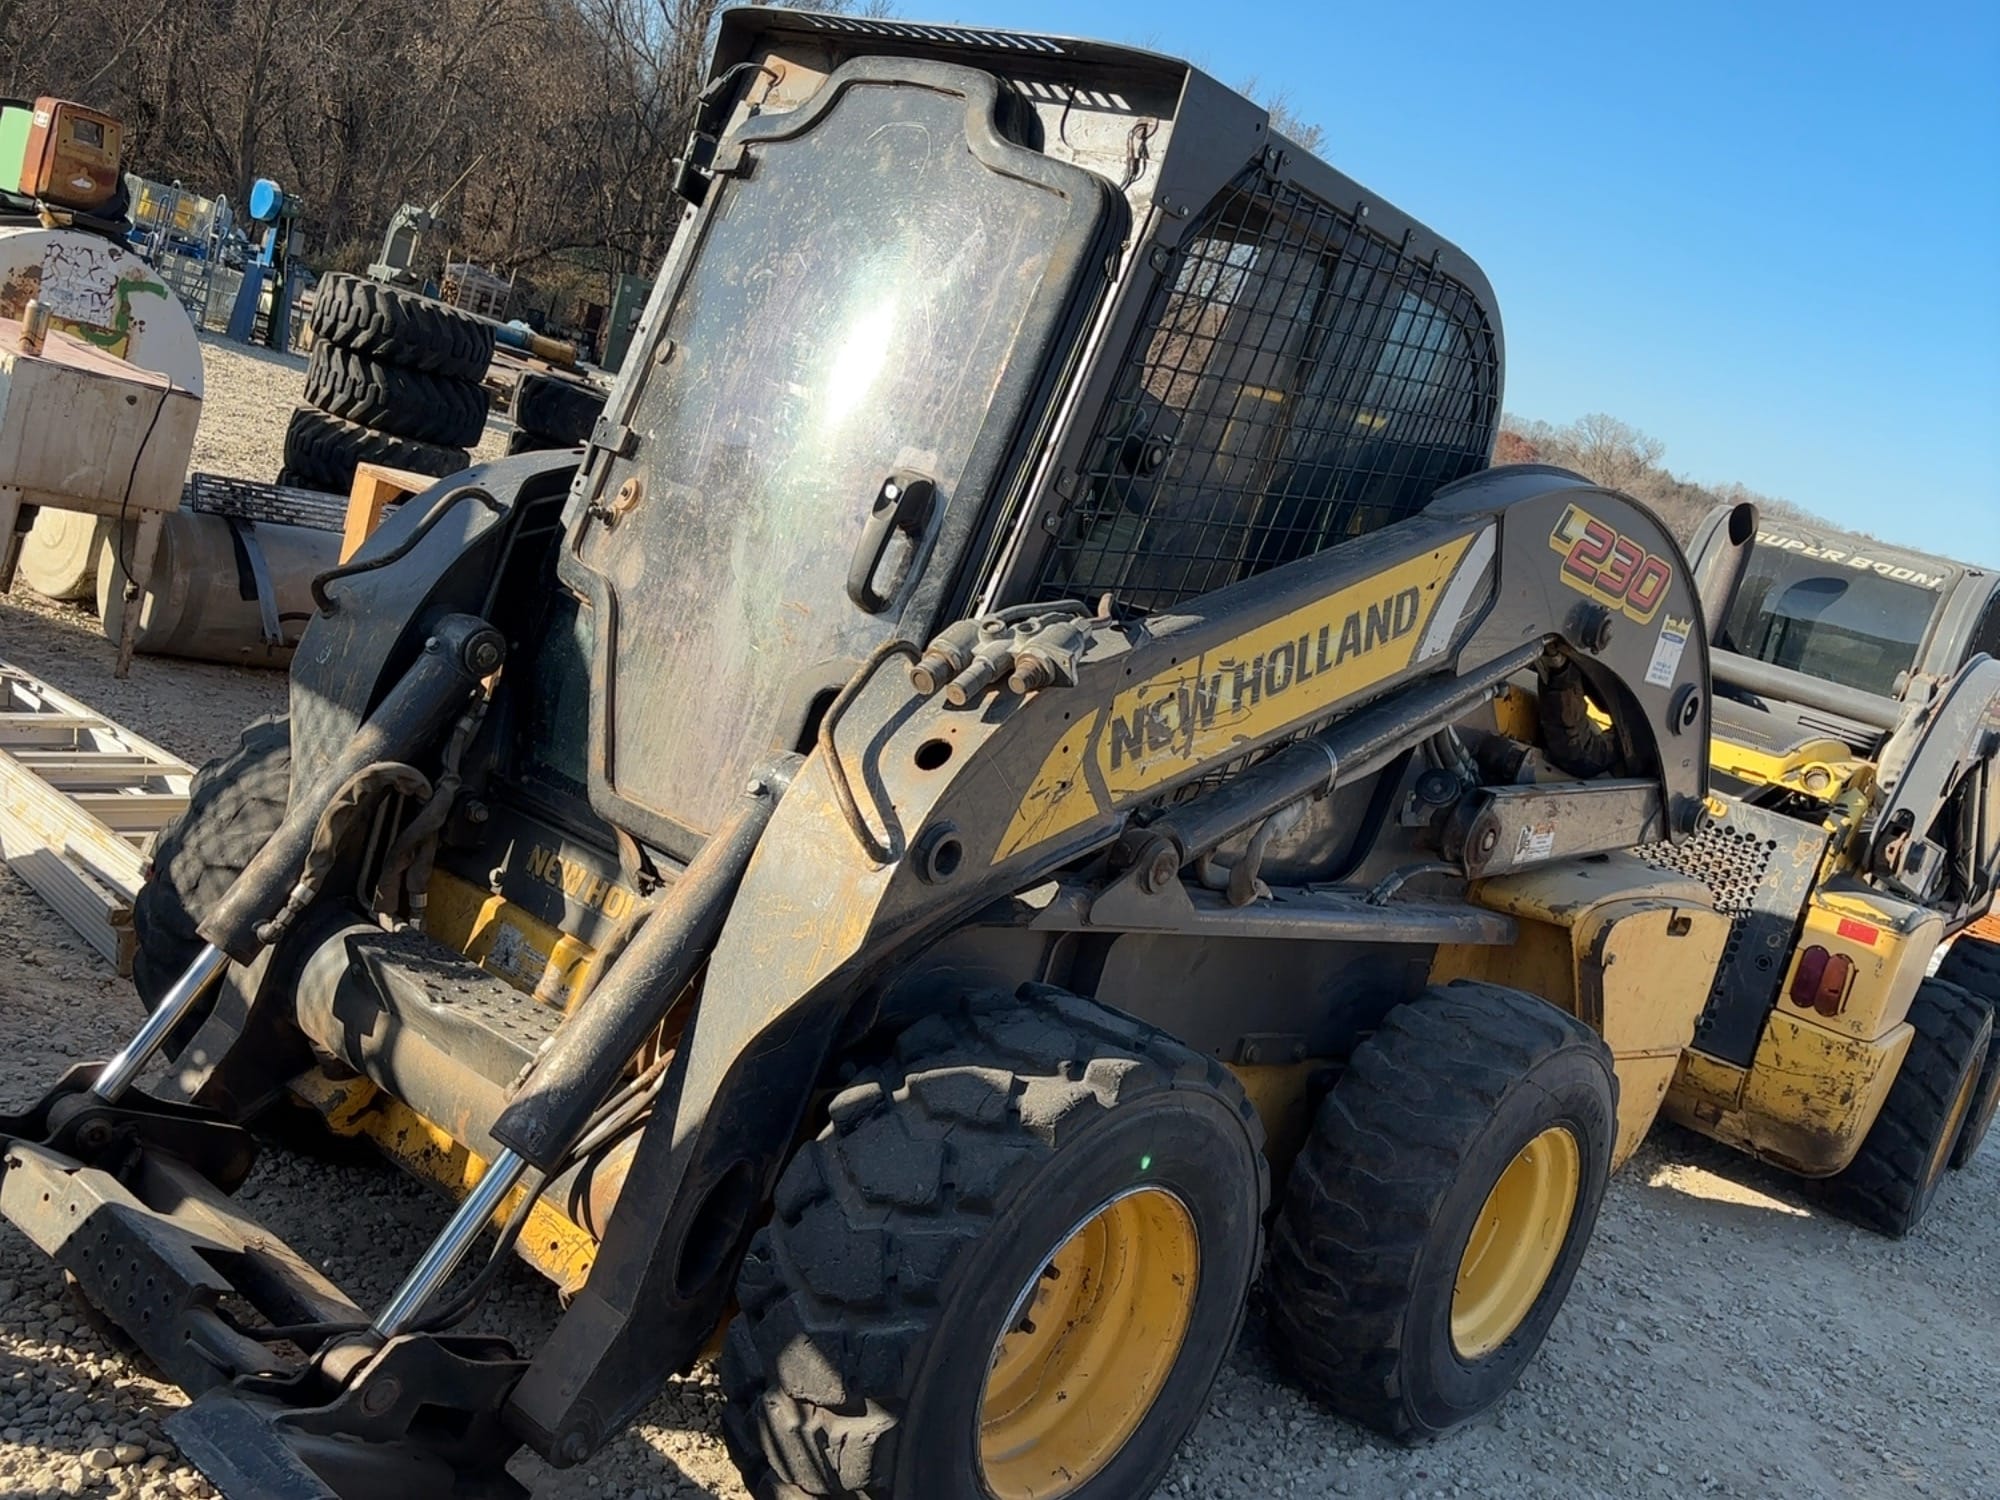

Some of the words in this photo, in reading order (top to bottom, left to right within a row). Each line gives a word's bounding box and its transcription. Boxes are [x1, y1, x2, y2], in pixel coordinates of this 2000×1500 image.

[1552, 505, 1672, 617] L230
[1754, 531, 1846, 563] SUPER
[1110, 673, 1222, 773] NEW
[1231, 585, 1420, 716] HOLLAND
[525, 844, 588, 898] NEW
